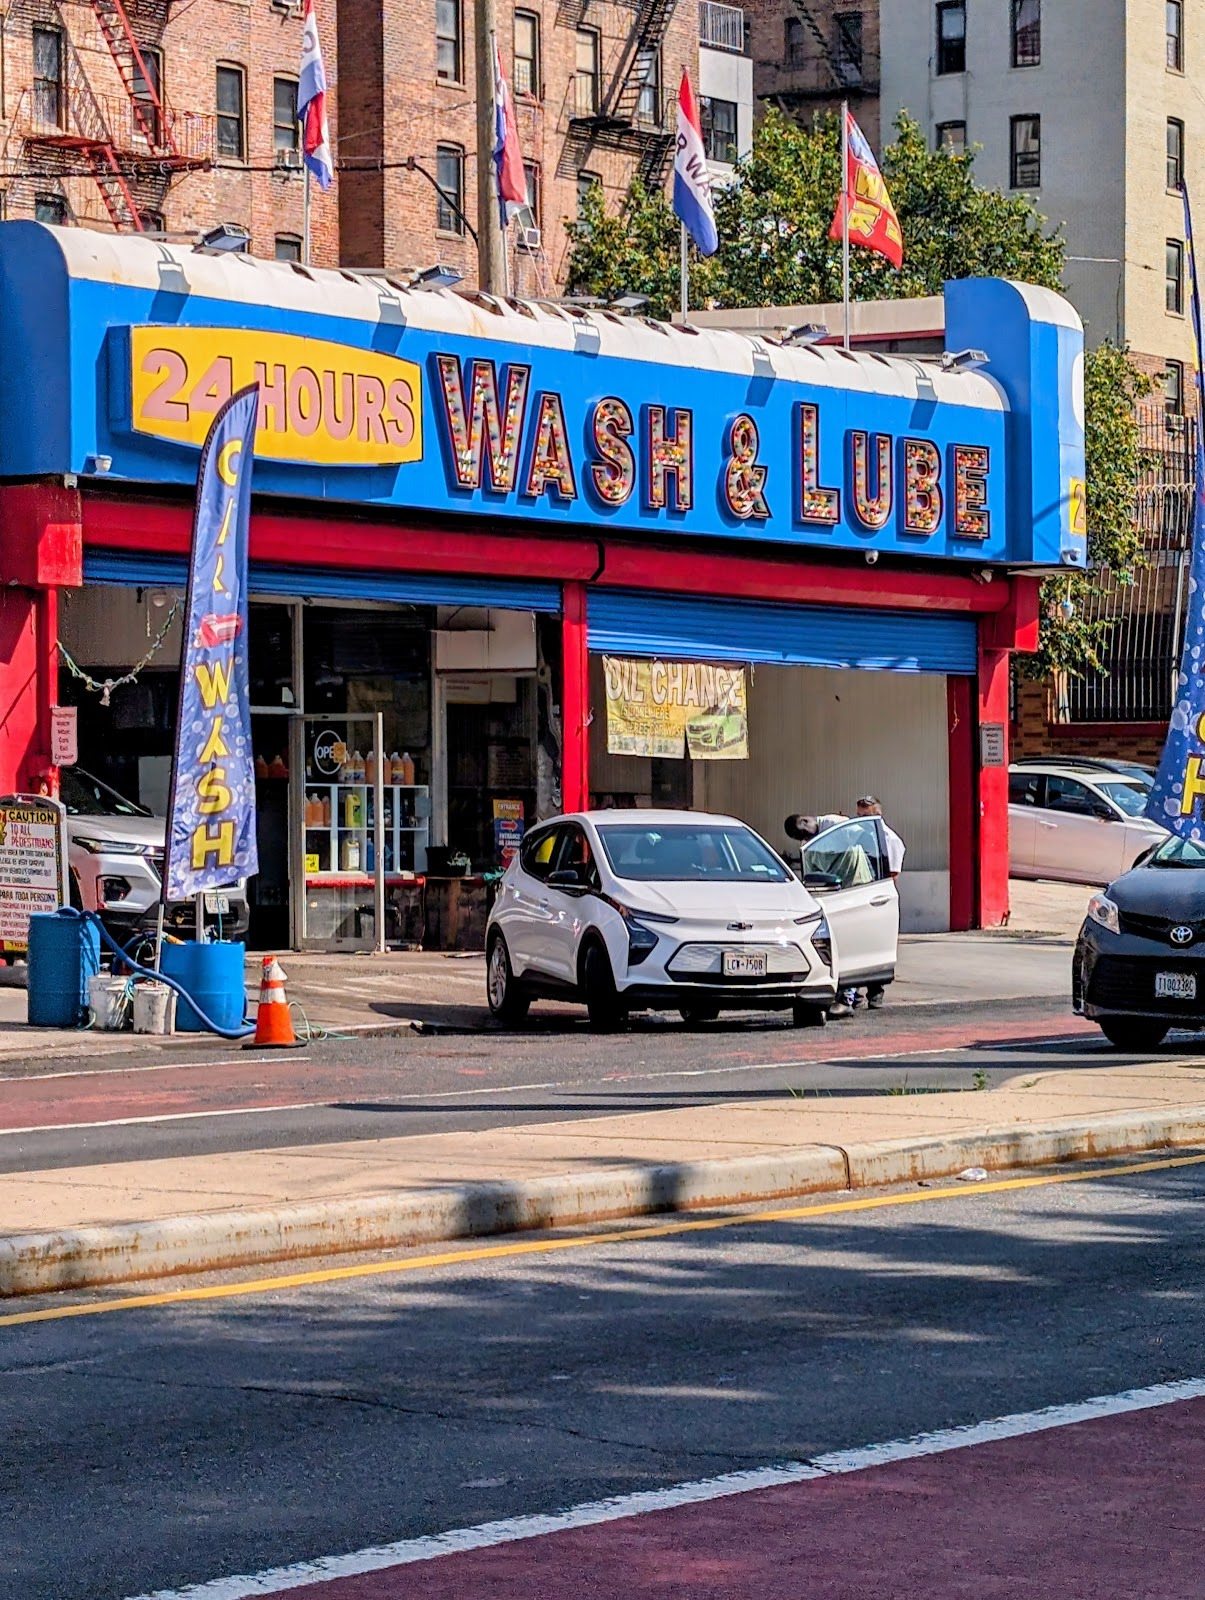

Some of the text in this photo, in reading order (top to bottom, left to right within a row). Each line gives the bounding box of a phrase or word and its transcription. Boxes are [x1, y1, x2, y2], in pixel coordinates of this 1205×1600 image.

[140, 347, 417, 448] 24 HOURS
[431, 351, 992, 541] WASH & LUBE
[604, 657, 744, 708] OIL CHANGE
[316, 745, 334, 759] OPE
[8, 811, 54, 823] CAUTION
[11, 836, 55, 850] PEDESTRIANS
